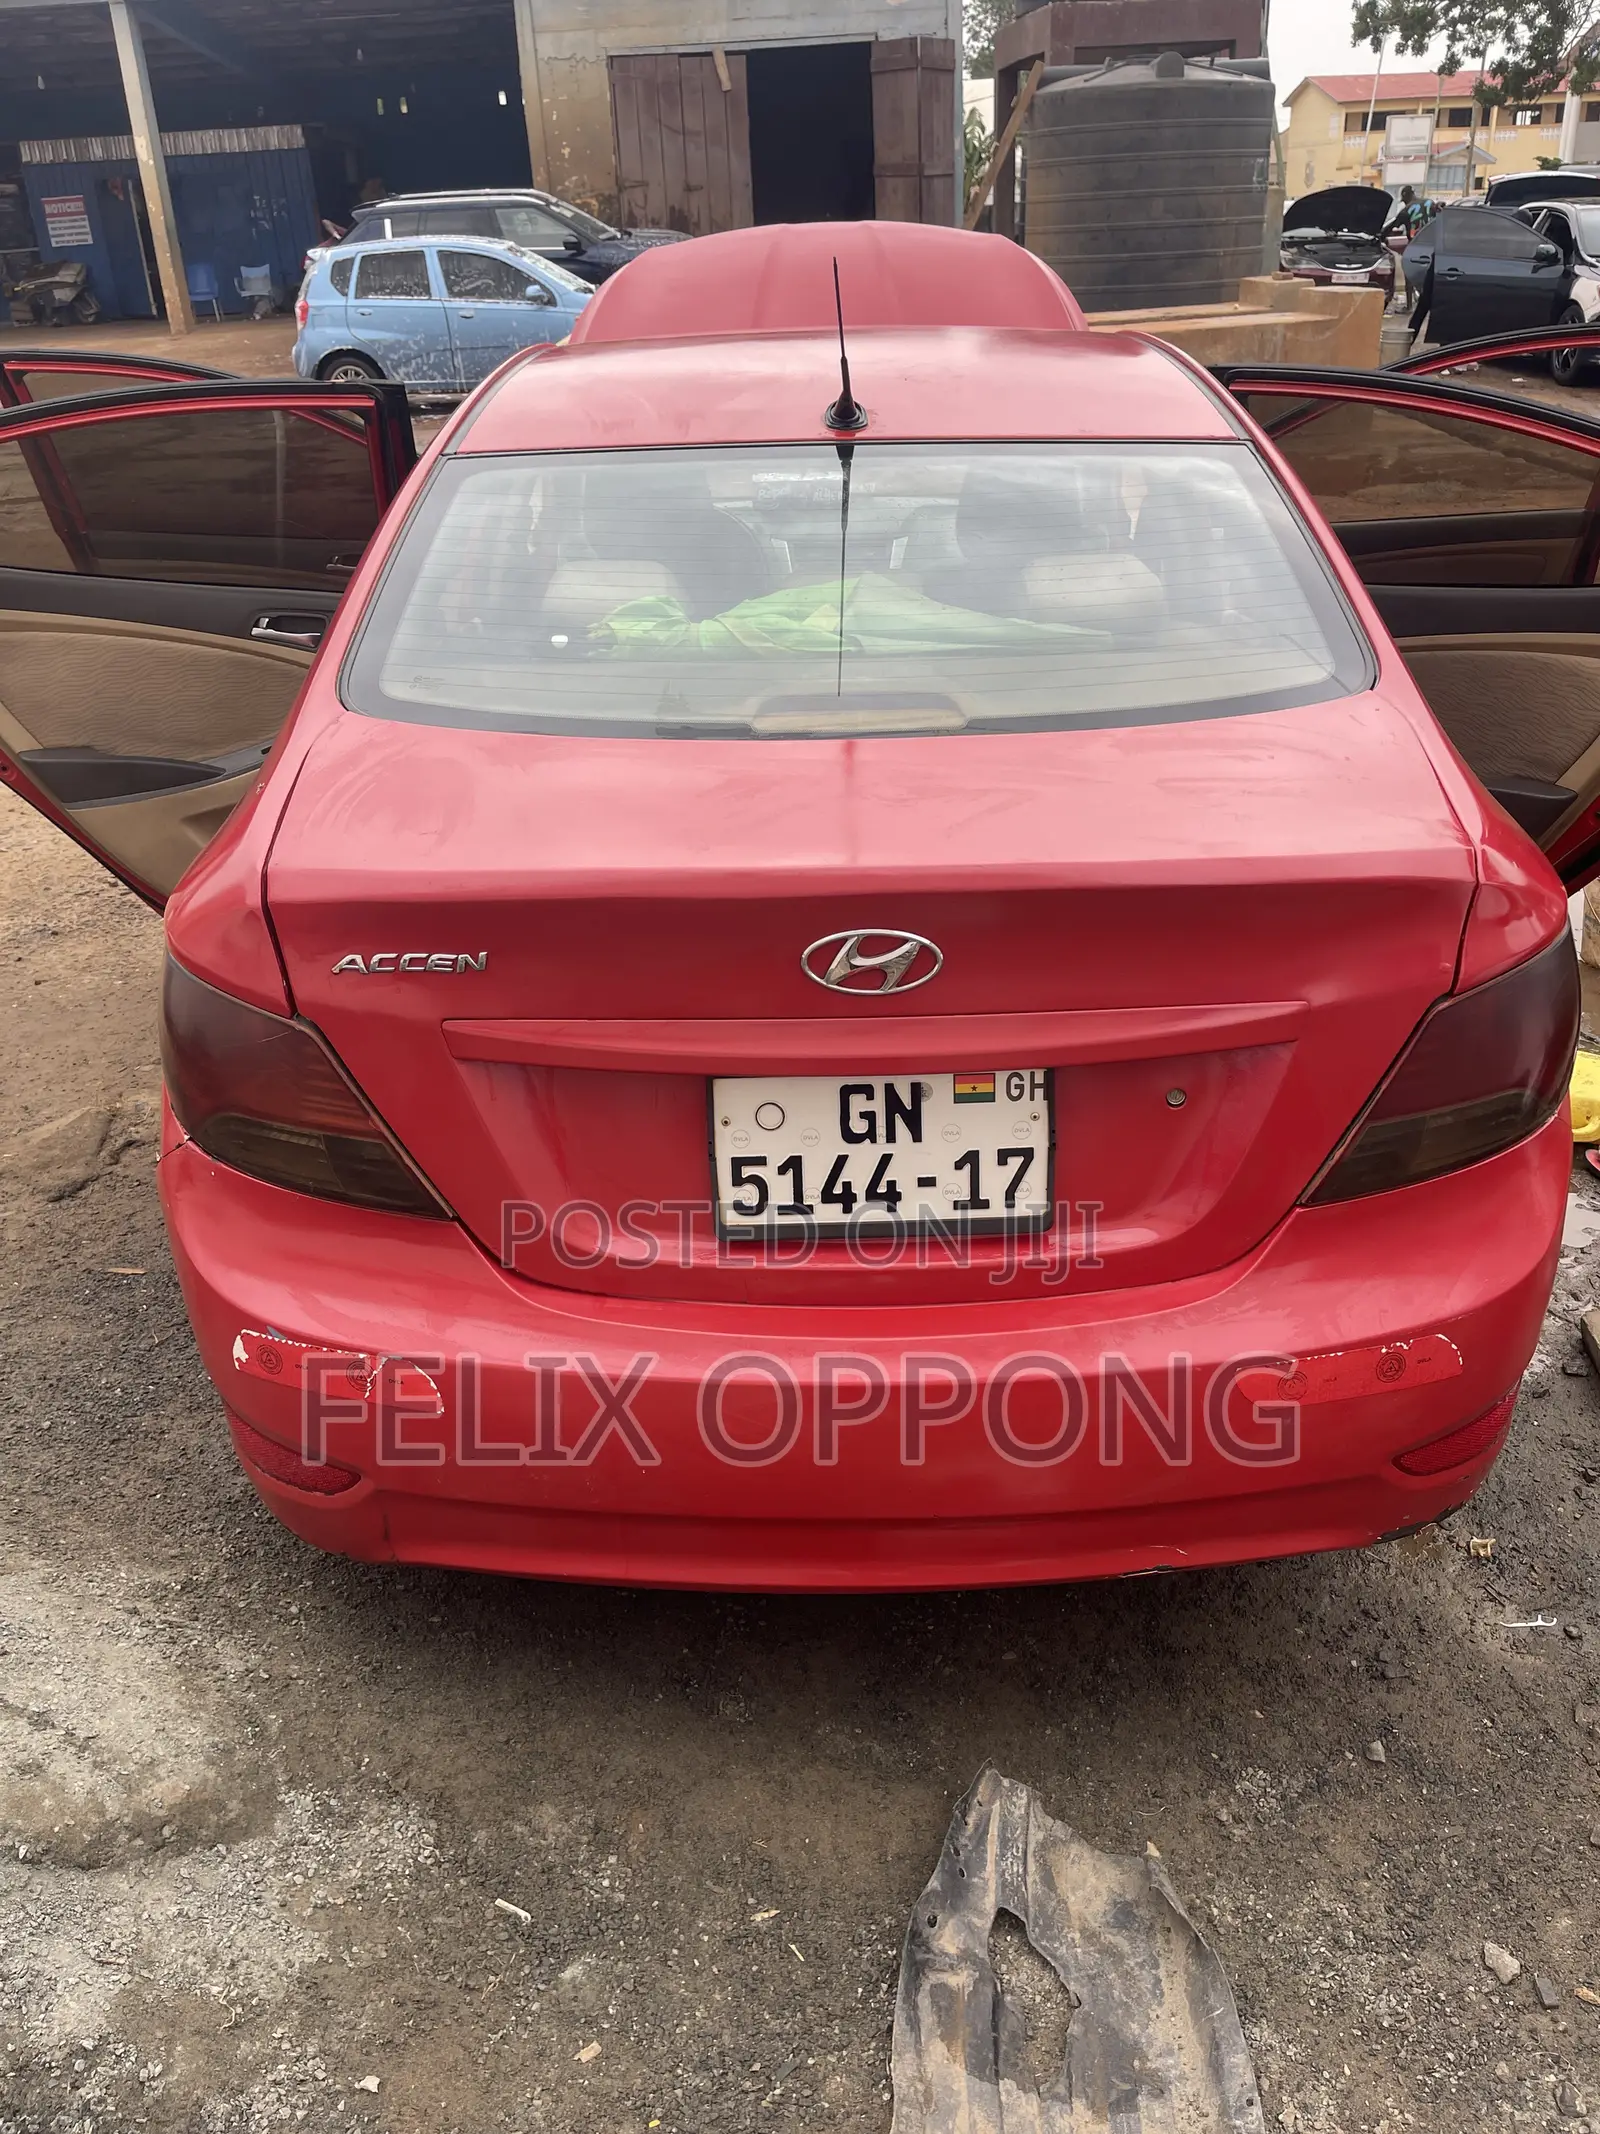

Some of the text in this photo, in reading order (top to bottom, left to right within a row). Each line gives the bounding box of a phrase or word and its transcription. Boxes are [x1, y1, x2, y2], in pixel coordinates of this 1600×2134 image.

[1408, 200, 1432, 222] 21
[331, 951, 488, 974] ACCEN
[1005, 1071, 1048, 1101] GH
[839, 1082, 922, 1144] GN
[731, 1147, 1034, 1216] 5144-17
